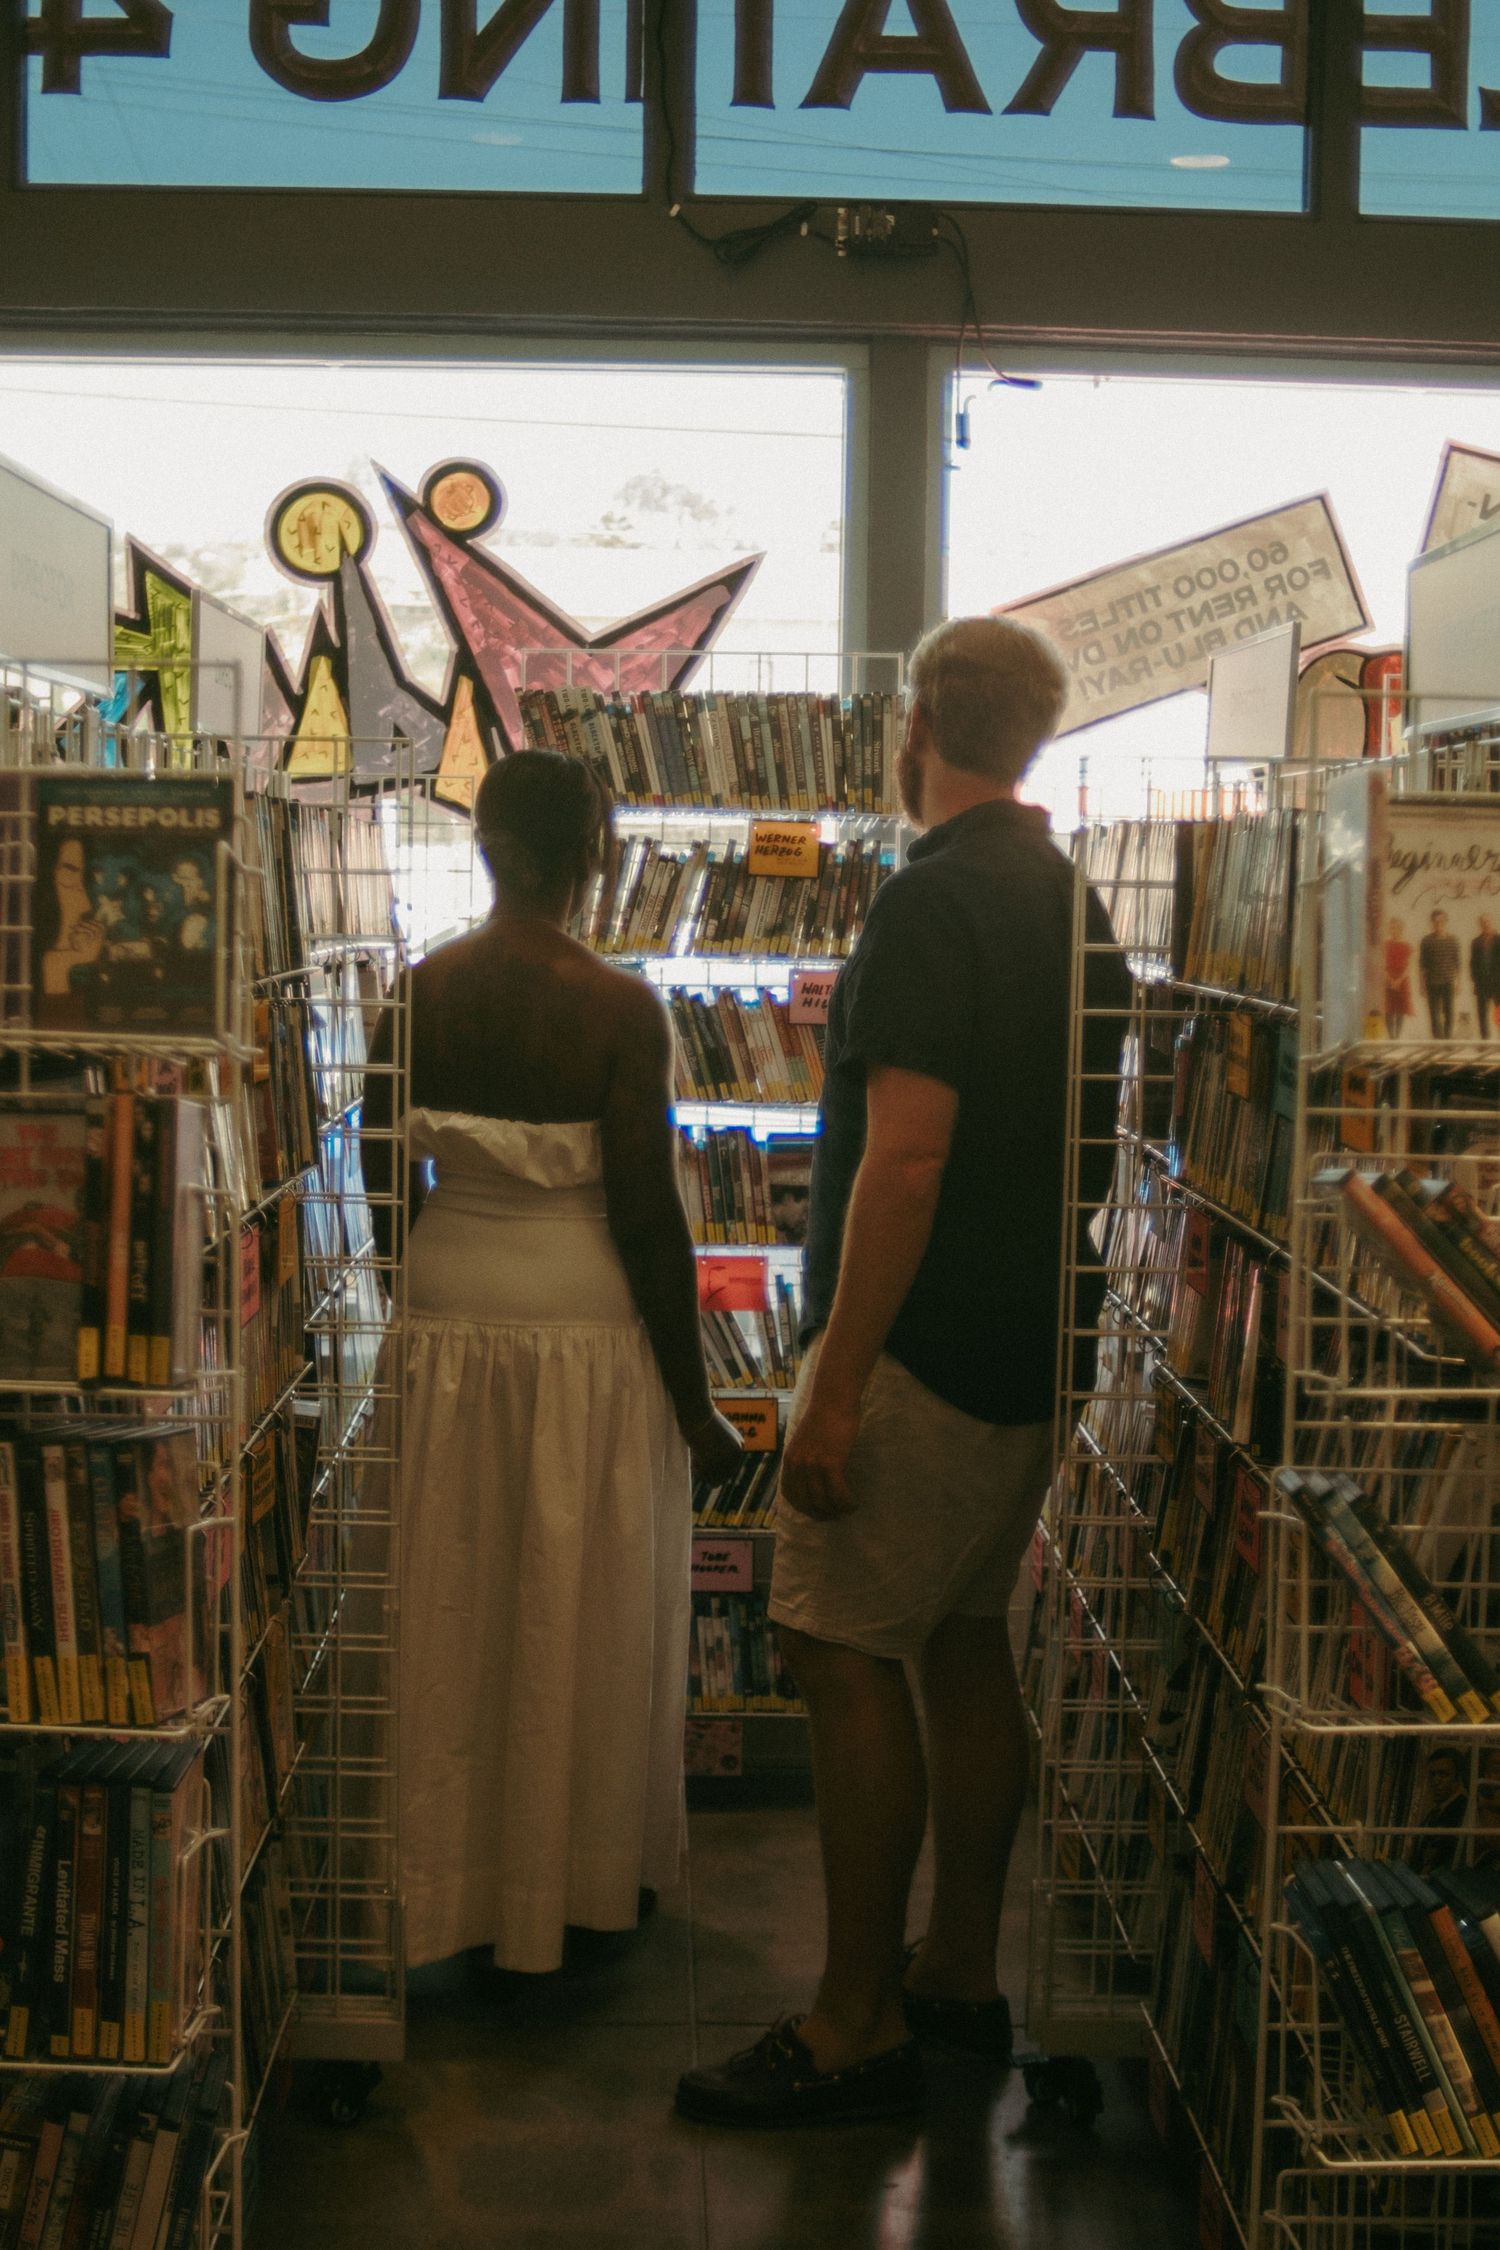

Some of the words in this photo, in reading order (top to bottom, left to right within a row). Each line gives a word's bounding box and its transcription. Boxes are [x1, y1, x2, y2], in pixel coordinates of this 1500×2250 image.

[47, 805, 221, 829] PERSEPOLIS
[754, 844, 803, 857] HERZOG
[755, 833, 807, 844] WERNER
[801, 982, 833, 995] WALT
[802, 997, 829, 1008] HIL
[51, 1539, 66, 1593] DREAMS
[29, 1589, 44, 1632] AWAY
[57, 1602, 69, 1642] SUSHI
[131, 1828, 146, 1870] MADE
[20, 1838, 45, 1937] INMIGRANTE
[54, 1858, 72, 1936] Levitated
[132, 1875, 146, 1894] IN
[127, 1900, 146, 1937] L.A.
[53, 1939, 70, 1983] Mass
[1392, 2013, 1432, 2082] STAIRWELL
